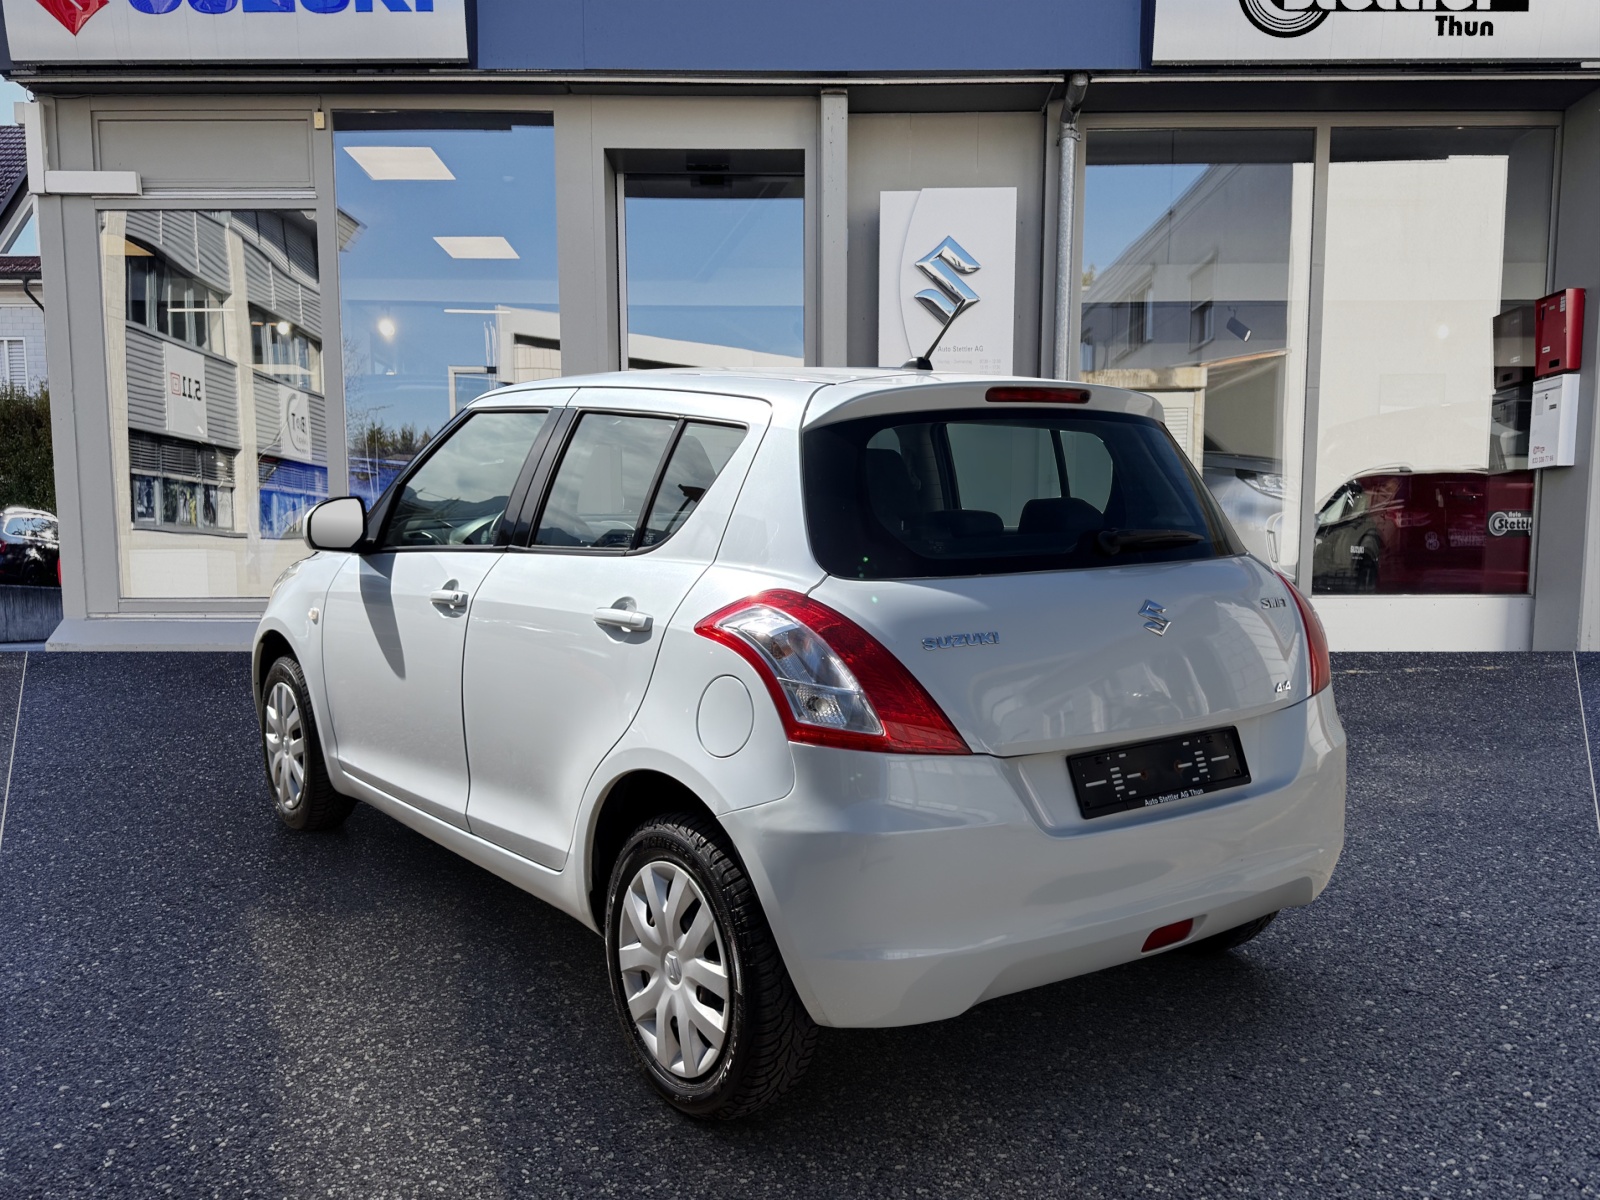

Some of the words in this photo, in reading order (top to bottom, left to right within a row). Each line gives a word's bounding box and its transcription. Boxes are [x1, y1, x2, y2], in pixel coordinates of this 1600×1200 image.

[1435, 15, 1494, 37] Thun
[938, 345, 951, 353] Auto
[952, 345, 973, 353] Stettler
[974, 345, 984, 353] AG
[922, 631, 1000, 651] SUZUKI
[1144, 798, 1159, 807] Auto
[1158, 793, 1179, 803] Stettler
[1180, 790, 1189, 798] AG
[1189, 788, 1204, 796] Thun
